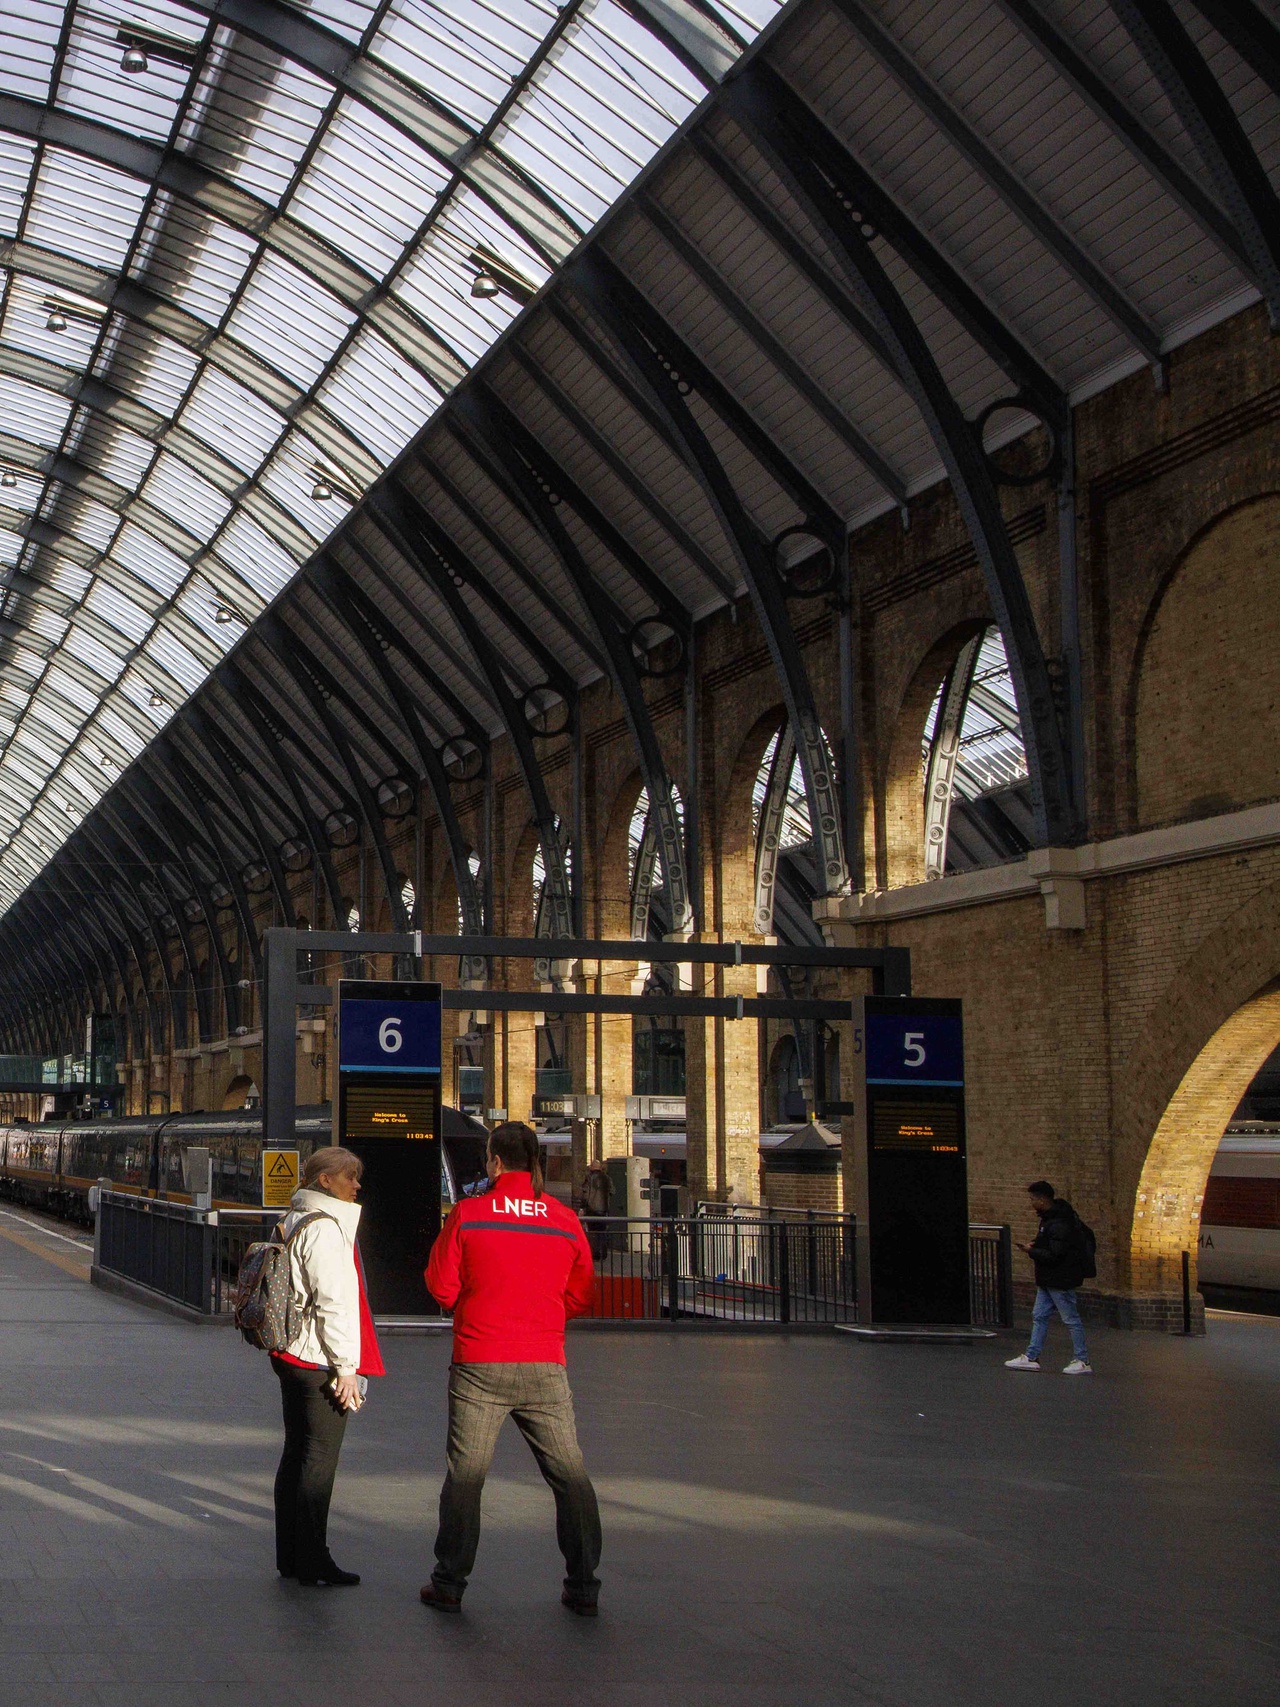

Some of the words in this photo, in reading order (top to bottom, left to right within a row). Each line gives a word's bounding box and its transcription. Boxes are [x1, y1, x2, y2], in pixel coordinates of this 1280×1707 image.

[378, 1017, 403, 1053] 6
[904, 1032, 926, 1067] 5
[492, 1195, 548, 1218] LNER
